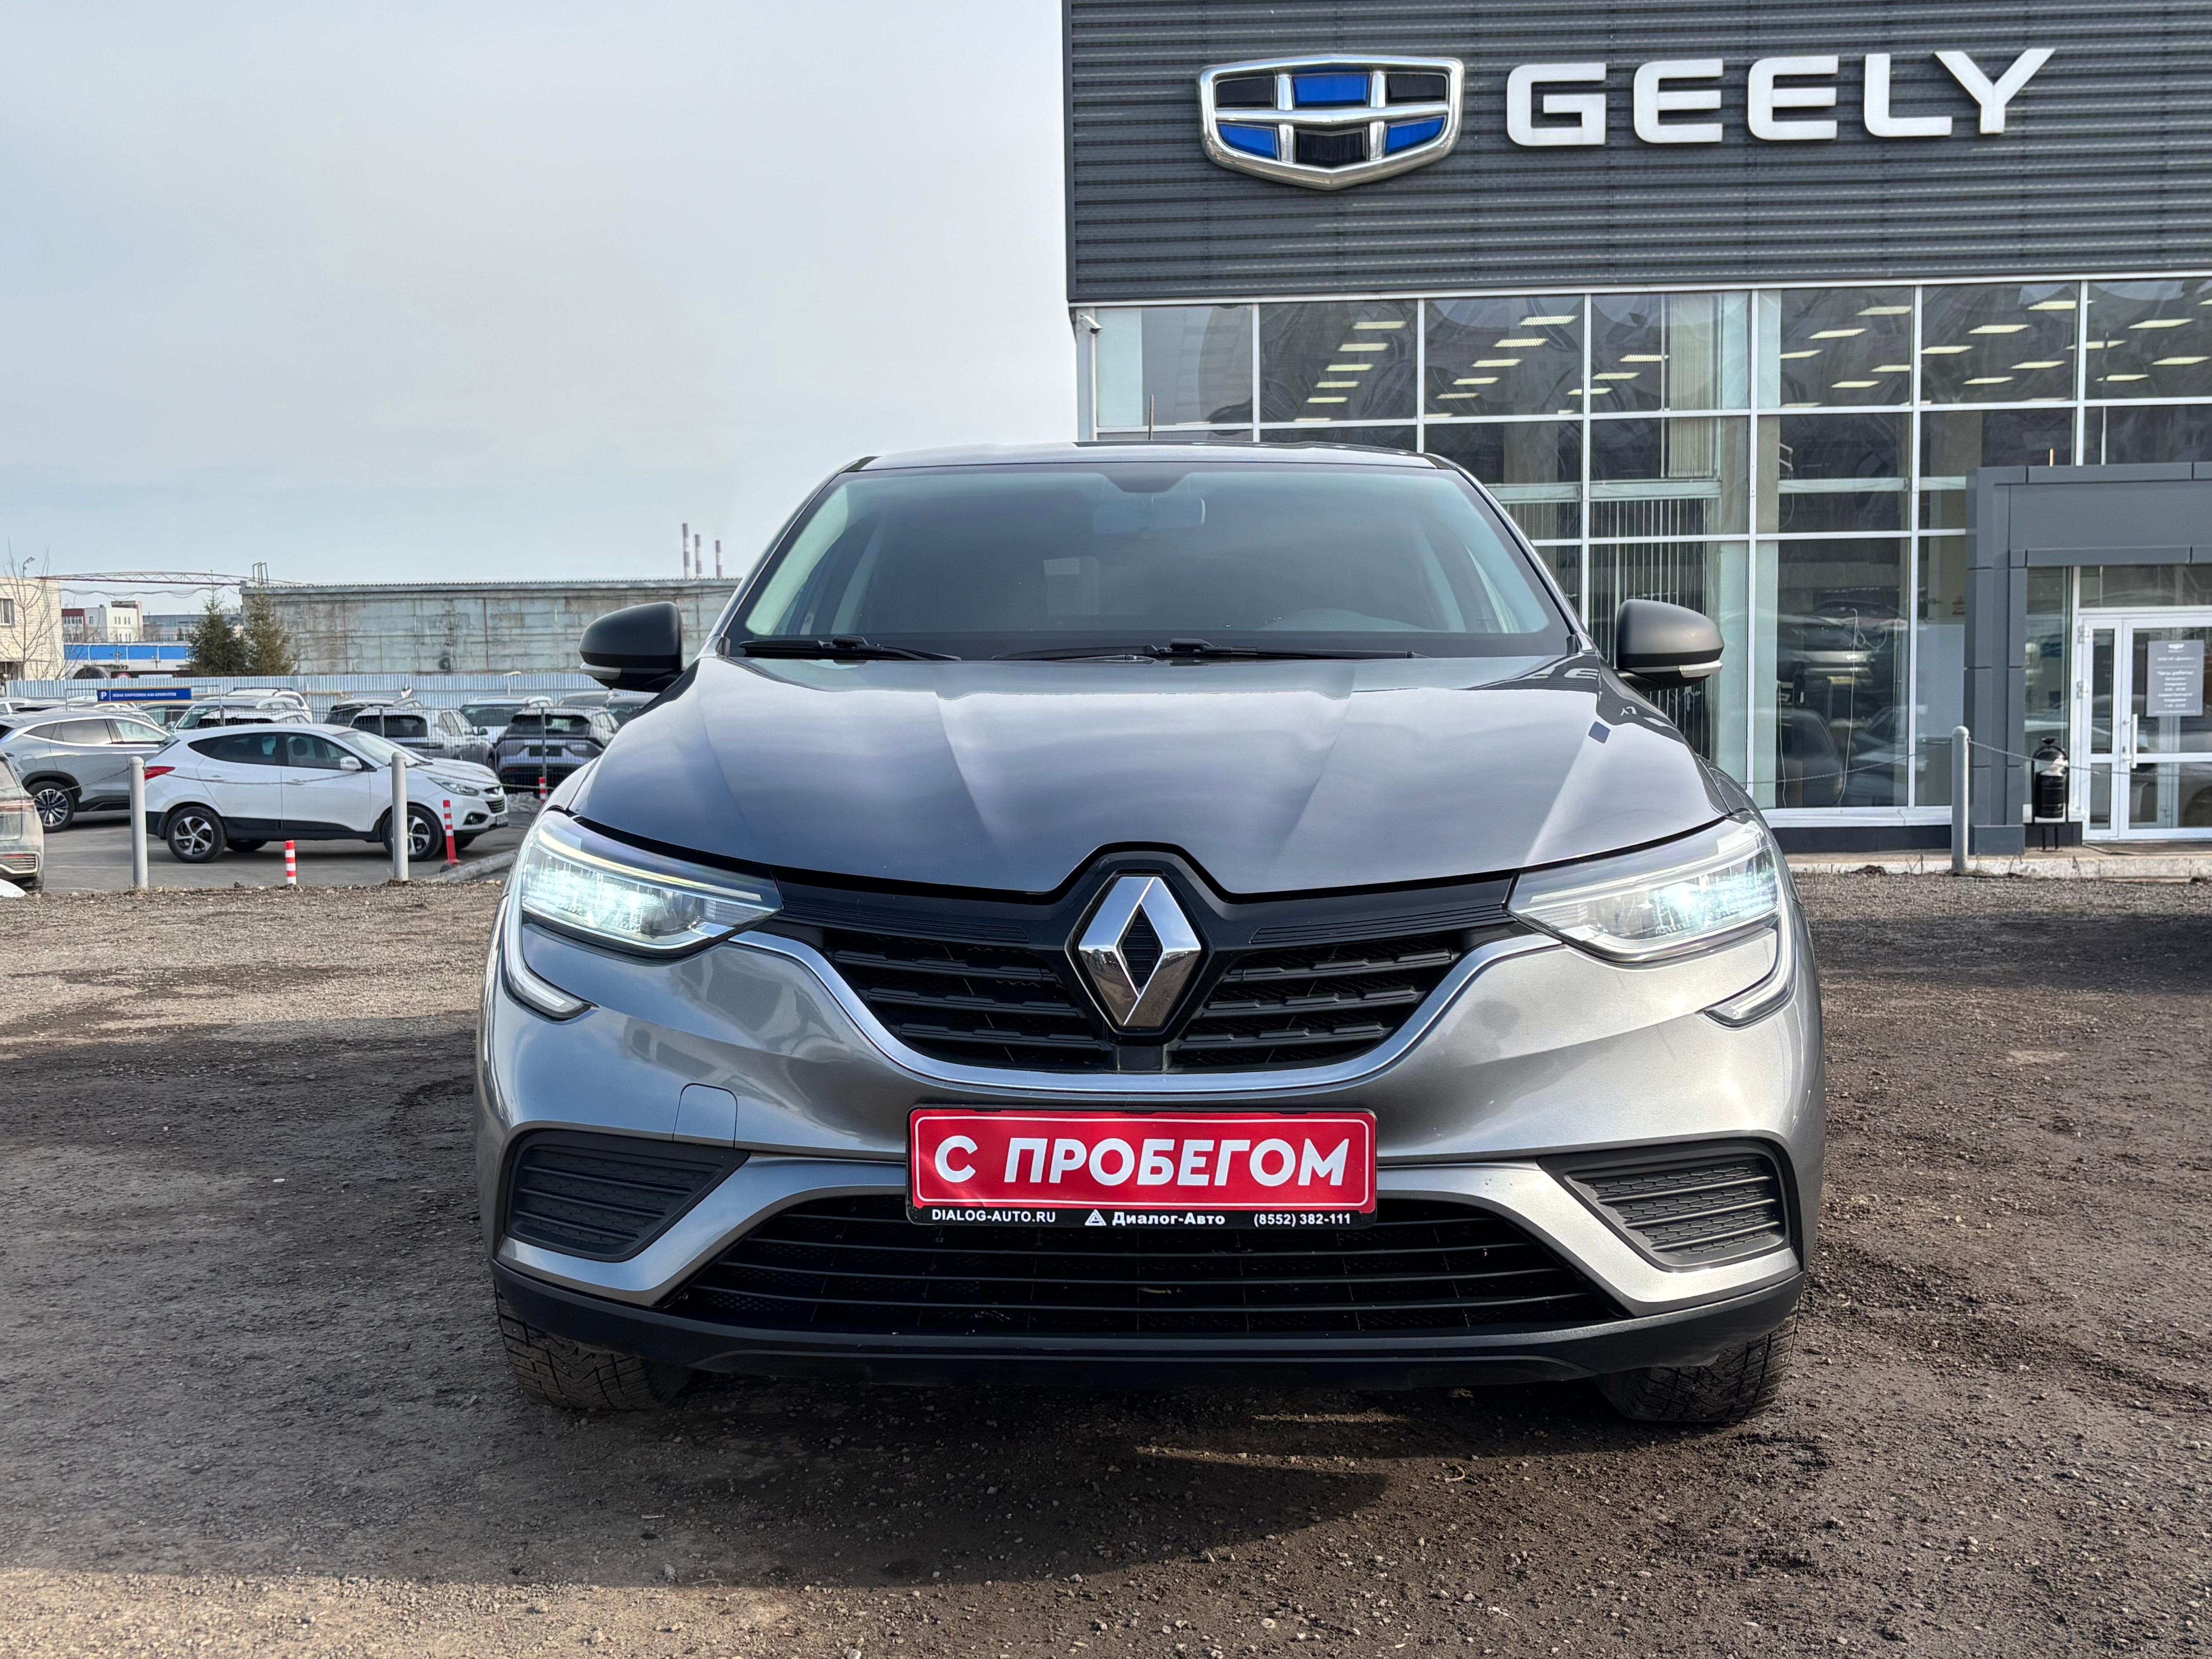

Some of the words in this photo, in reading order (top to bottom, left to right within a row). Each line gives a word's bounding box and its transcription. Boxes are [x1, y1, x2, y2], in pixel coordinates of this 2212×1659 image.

[1506, 47, 2056, 146] GEELY
[934, 1135, 979, 1183] С
[1004, 1137, 1350, 1187] ПРОБЕГОМ
[932, 1208, 1056, 1223] DIALOG-AUTO.RU
[1112, 1211, 1226, 1226] Диалог-Авто
[1254, 1213, 1297, 1227] (8552)
[1299, 1213, 1351, 1225] 382-111
